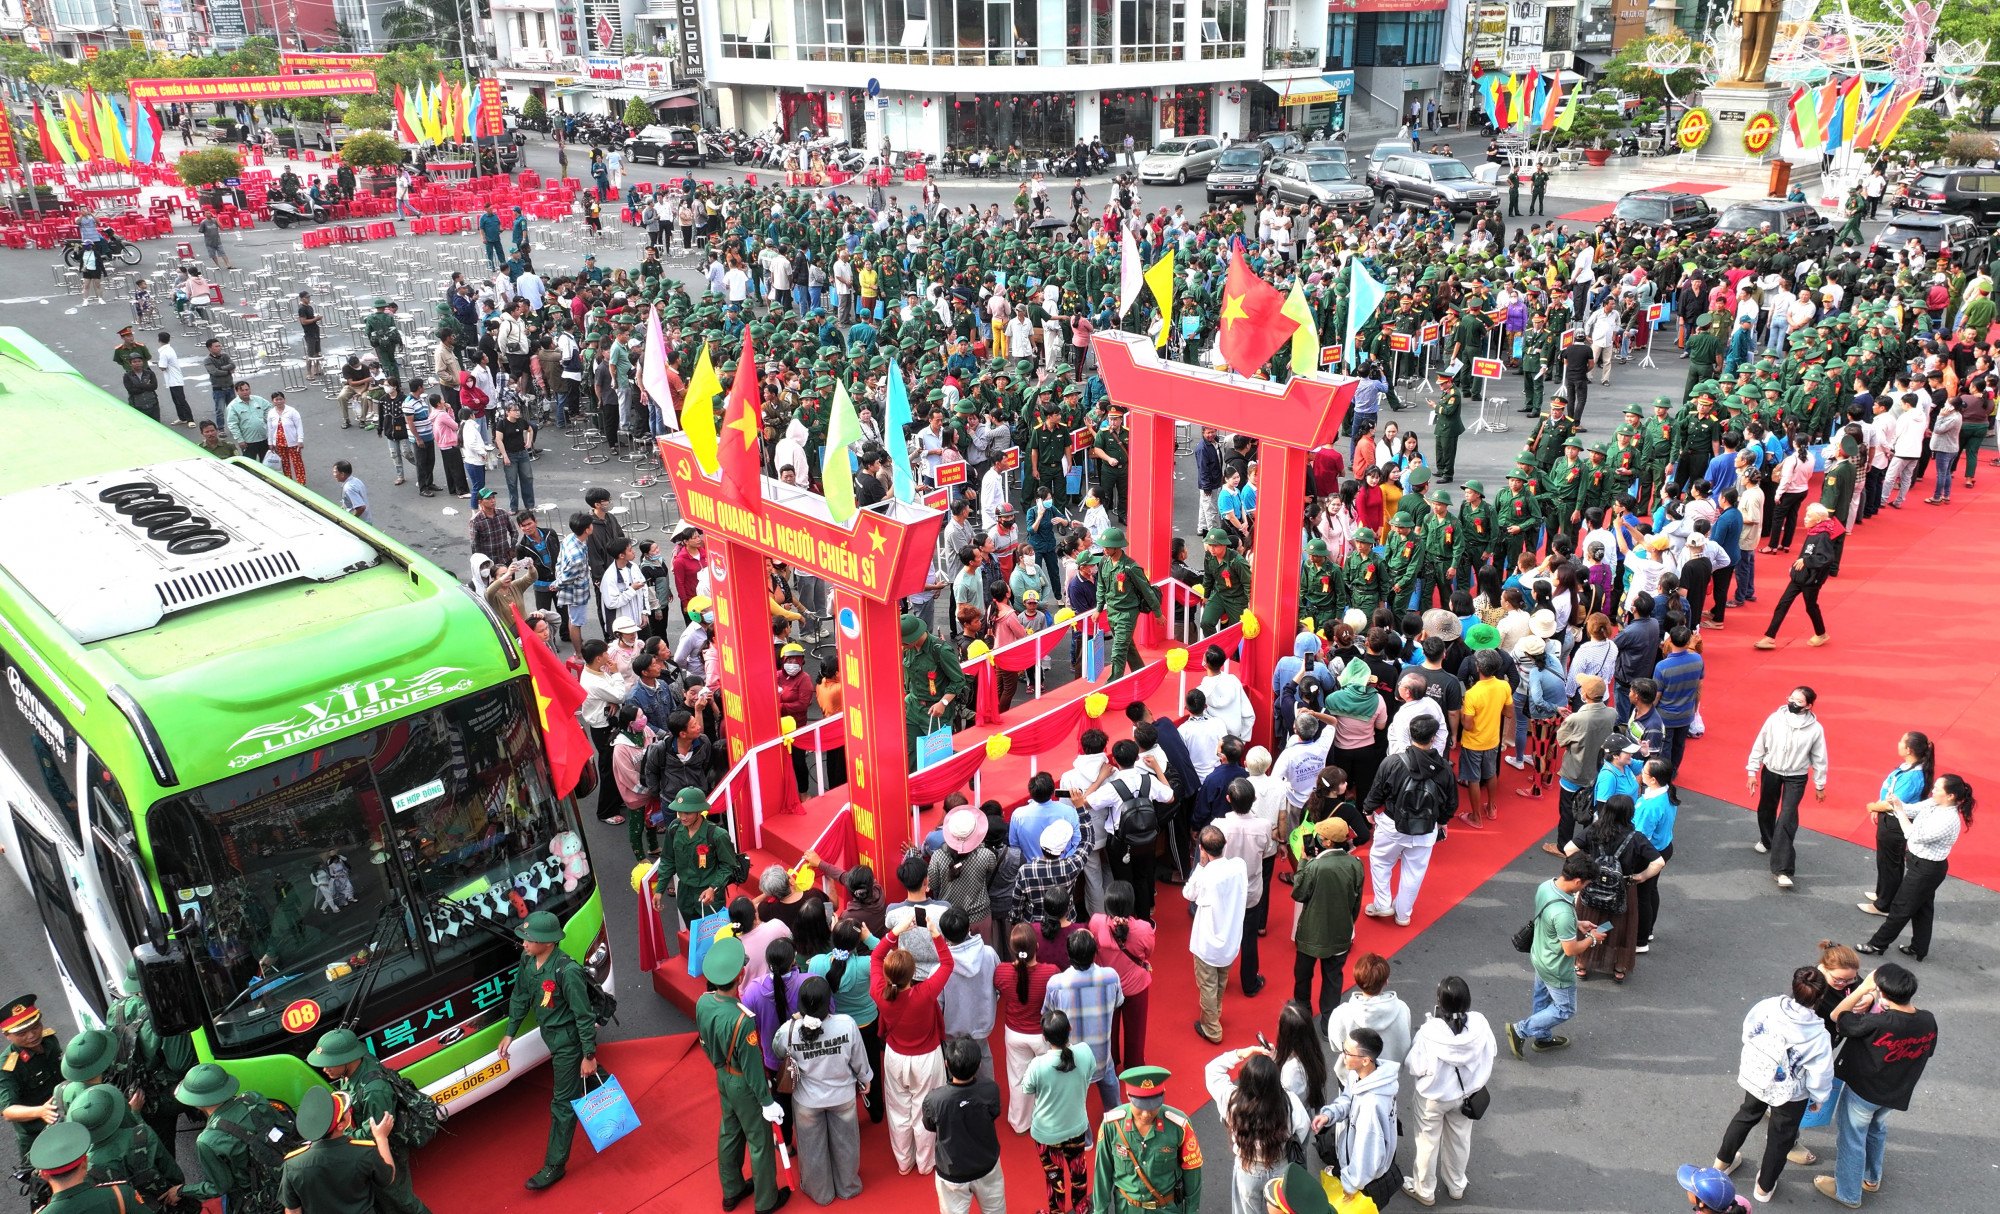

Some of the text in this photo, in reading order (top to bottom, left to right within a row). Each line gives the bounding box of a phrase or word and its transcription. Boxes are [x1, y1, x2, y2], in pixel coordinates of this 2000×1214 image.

[203, 83, 217, 95] LAO
[283, 80, 300, 91] THEO
[686, 67, 703, 75] COFFEE
[687, 489, 877, 590] VINH QUANG LÀ NGƯỜI CHIẾN SĨ
[299, 677, 397, 721] VIP
[724, 688, 744, 723] THANH
[262, 681, 444, 753] LIMOUSINES
[849, 703, 864, 740] KHÓ
[855, 753, 865, 789] CÓ
[395, 784, 442, 809] XE HỢP ĐỒNG
[853, 803, 875, 841] THANH
[287, 1004, 316, 1030] 08
[802, 1046, 842, 1060] MOVEMENT
[823, 1033, 850, 1047] GLOBAL
